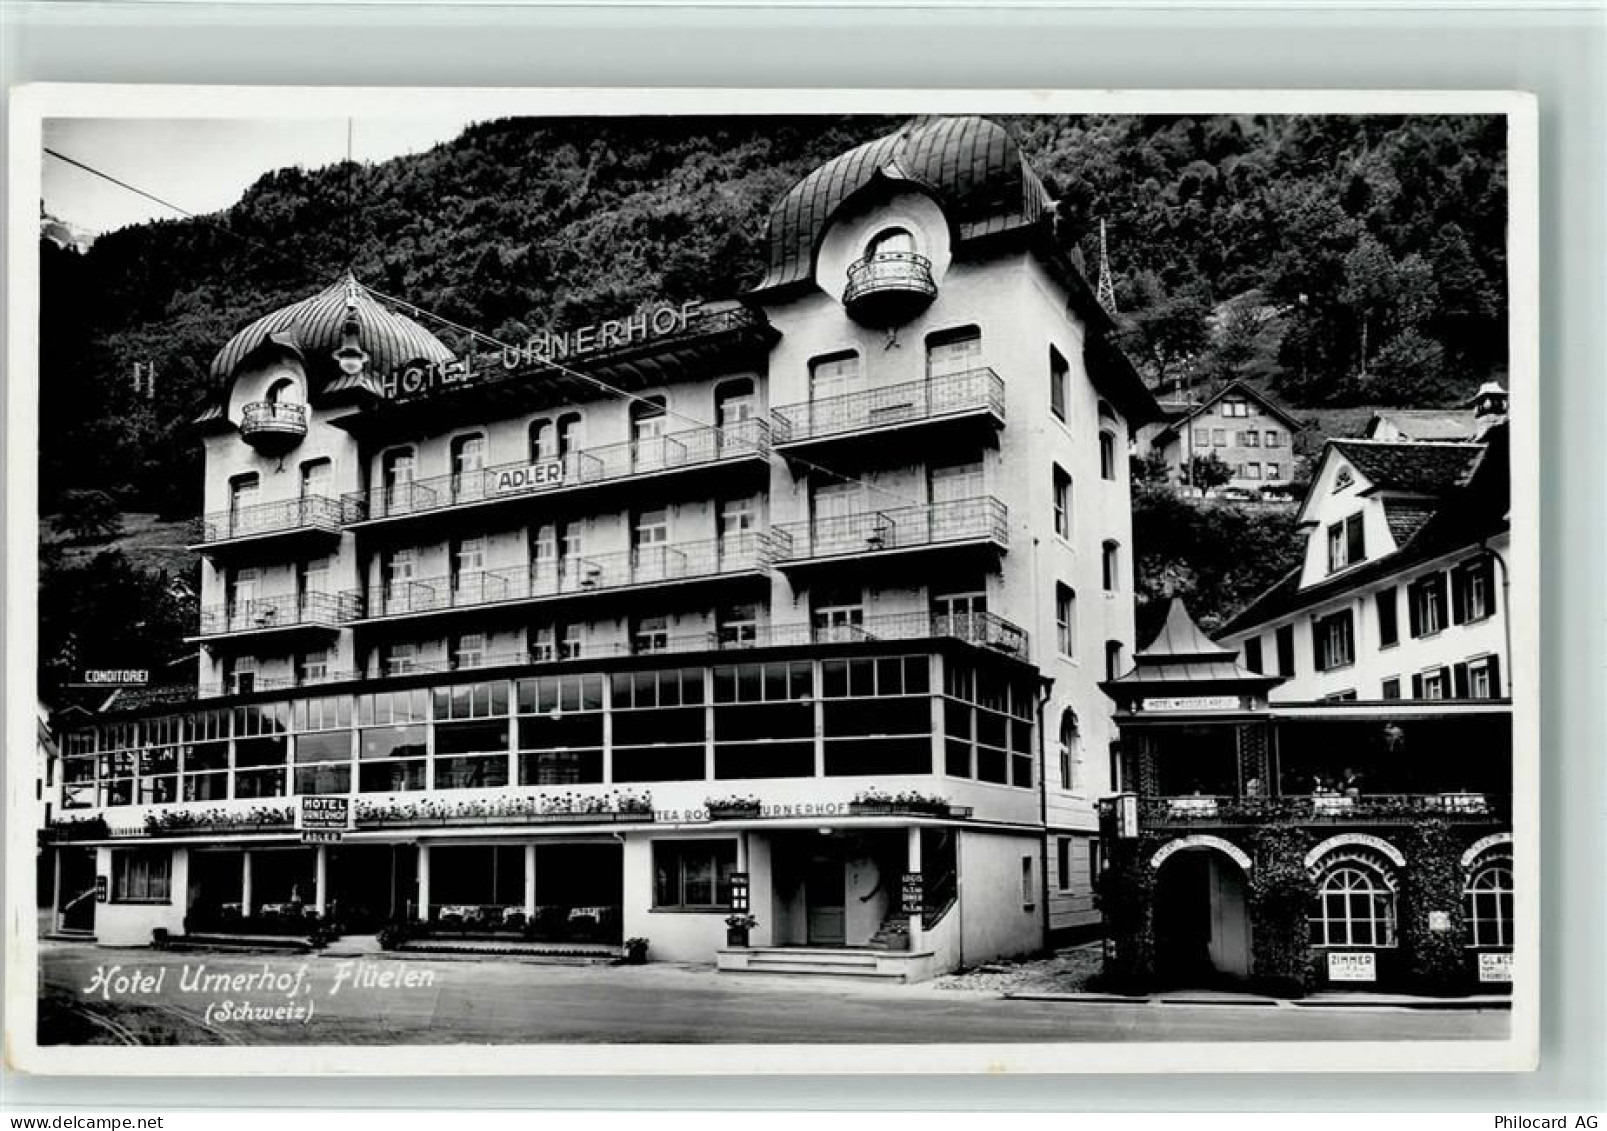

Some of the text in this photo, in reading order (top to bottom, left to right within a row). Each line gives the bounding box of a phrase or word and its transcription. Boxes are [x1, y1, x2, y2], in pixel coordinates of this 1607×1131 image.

[382, 301, 701, 398] HOTEL URNERHOF
[499, 464, 561, 490] ADLER
[85, 670, 149, 683] CONDITOREI
[304, 799, 346, 809] HOTEL
[656, 802, 846, 820] TEA ROO URNERHOF
[1331, 955, 1372, 966] ZIMMER
